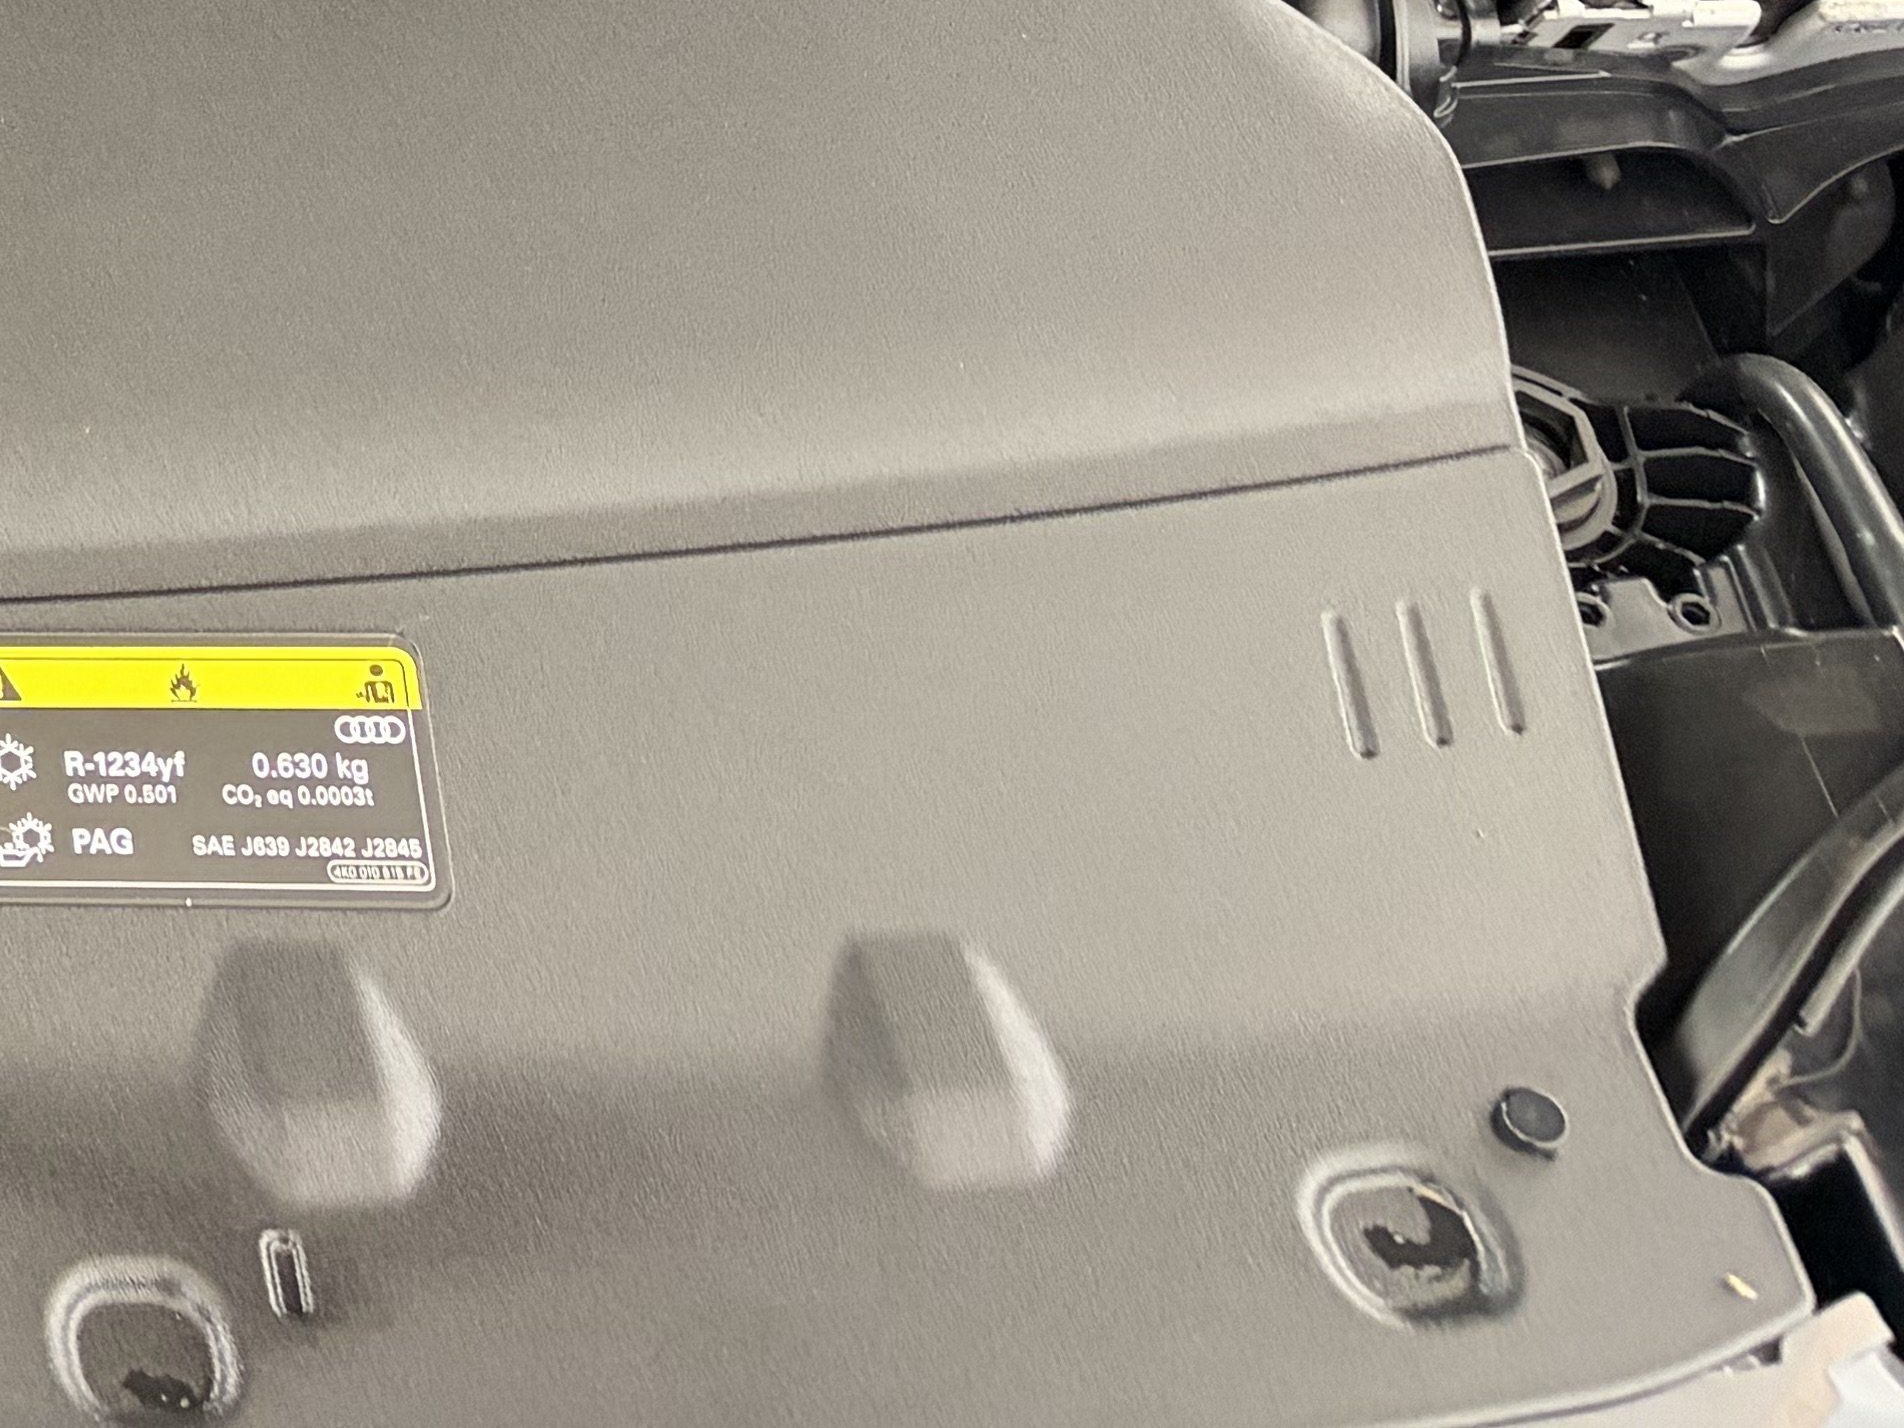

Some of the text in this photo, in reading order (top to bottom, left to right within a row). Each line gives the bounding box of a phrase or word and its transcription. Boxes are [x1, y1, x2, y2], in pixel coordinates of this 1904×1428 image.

[64, 750, 185, 782] R-1234yf
[252, 751, 369, 784] 0.630 kg
[68, 783, 177, 804] GWP 0.501
[267, 789, 293, 810] eq
[297, 785, 375, 806] 0.0003t
[72, 828, 134, 854] PAG
[193, 834, 422, 859] SAE J639 J2842 J2845
